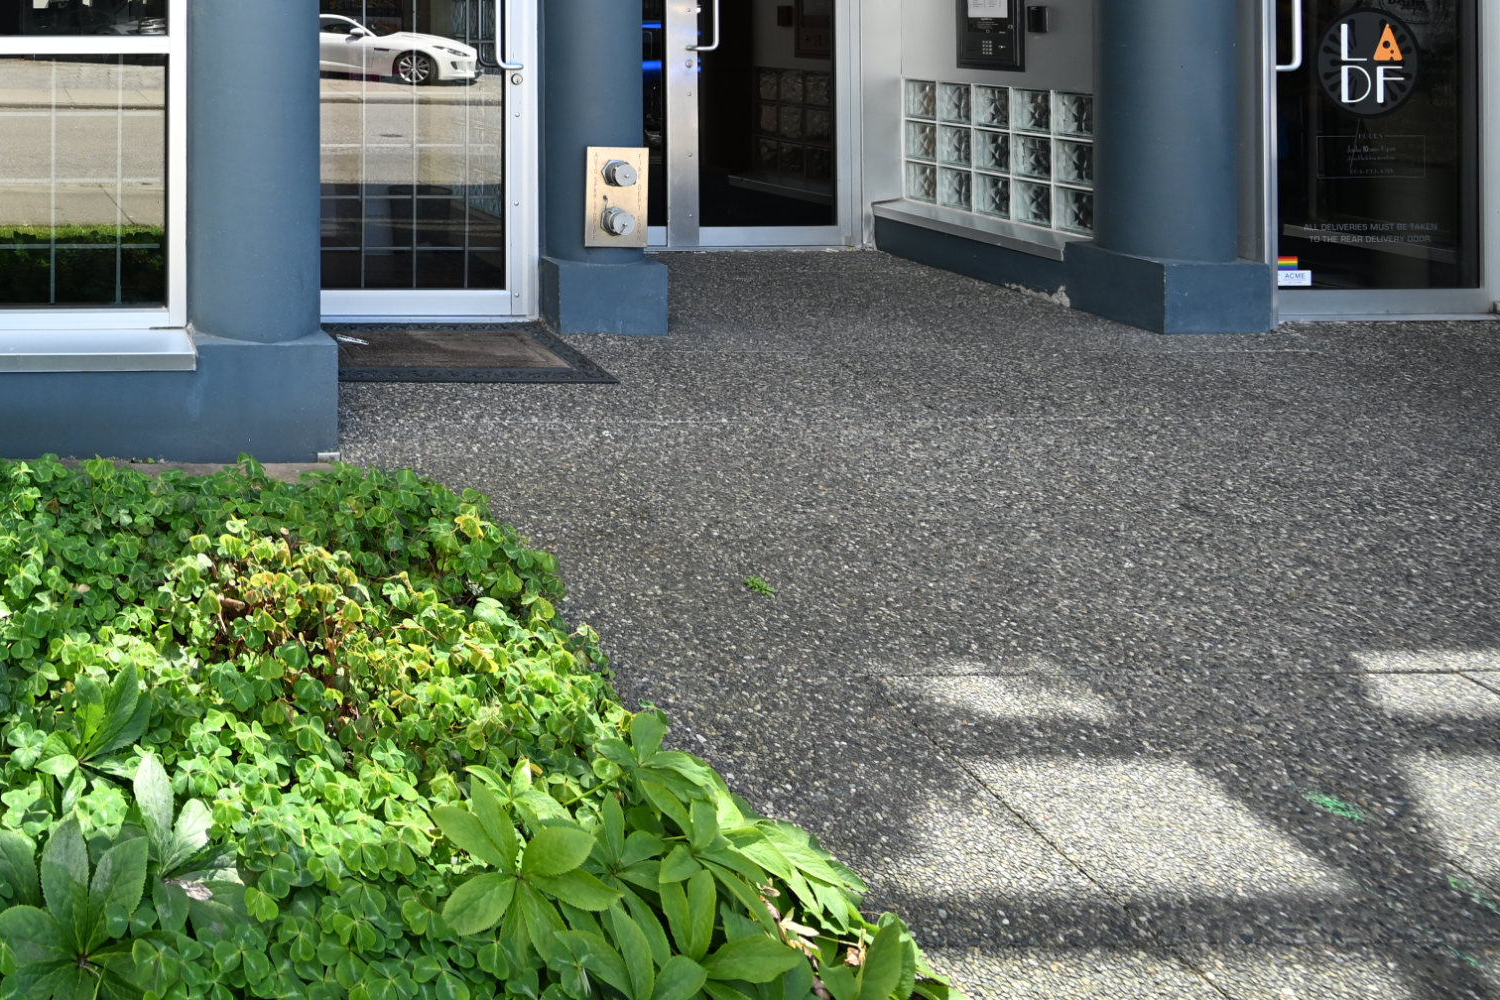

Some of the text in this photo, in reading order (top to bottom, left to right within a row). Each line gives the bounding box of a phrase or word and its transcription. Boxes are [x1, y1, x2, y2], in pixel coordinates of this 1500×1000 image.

[1340, 65, 1405, 104] DF
[1303, 223, 1438, 231] ALL DELIVERIES MUST BE TAKEN
[1309, 235, 1431, 243] TO THE REAR DELIVERY DOOR
